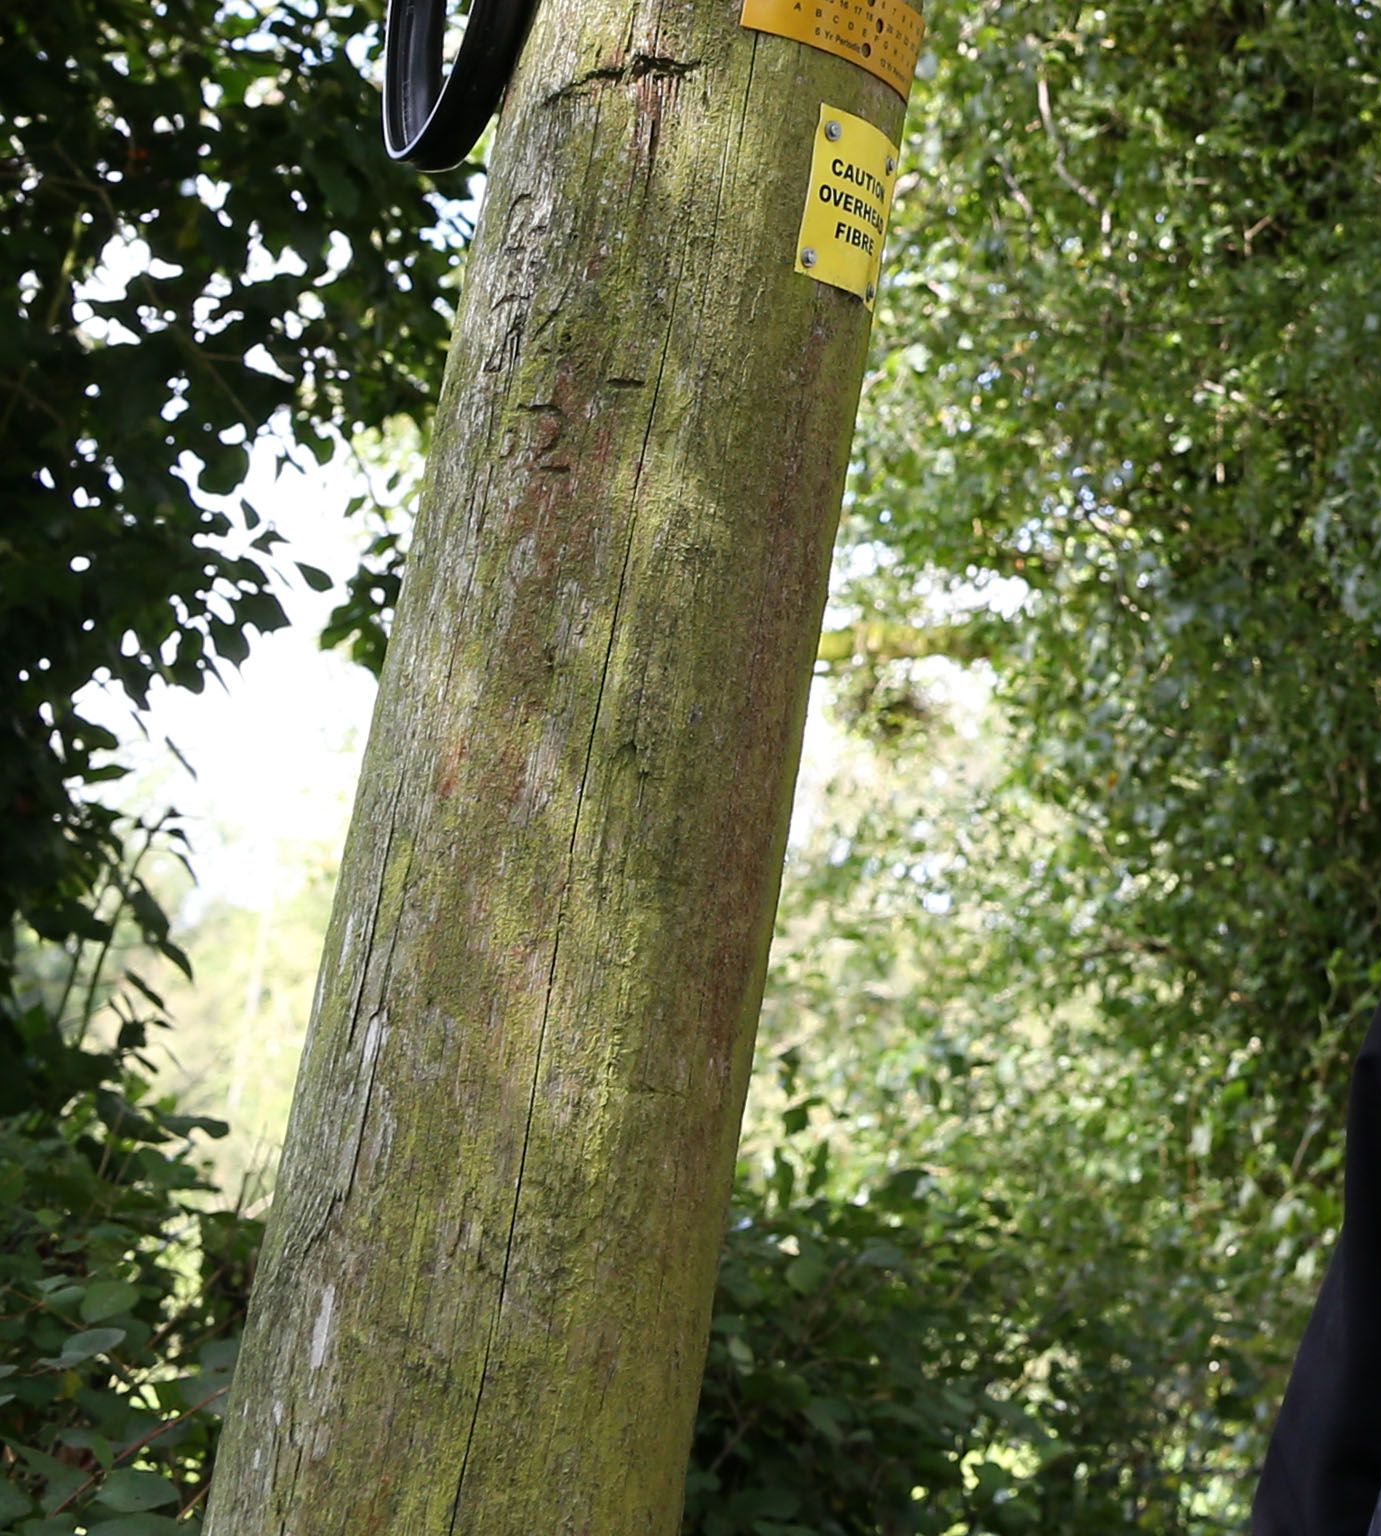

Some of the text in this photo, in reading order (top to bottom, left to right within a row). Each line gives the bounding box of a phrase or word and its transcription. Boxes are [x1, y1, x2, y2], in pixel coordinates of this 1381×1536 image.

[793, 2, 802, 12] A
[815, 8, 823, 18] B
[832, 15, 839, 25] C
[831, 158, 886, 205] CAUTION
[819, 184, 885, 236] OVERHEAD
[834, 221, 875, 257] FIBRE
